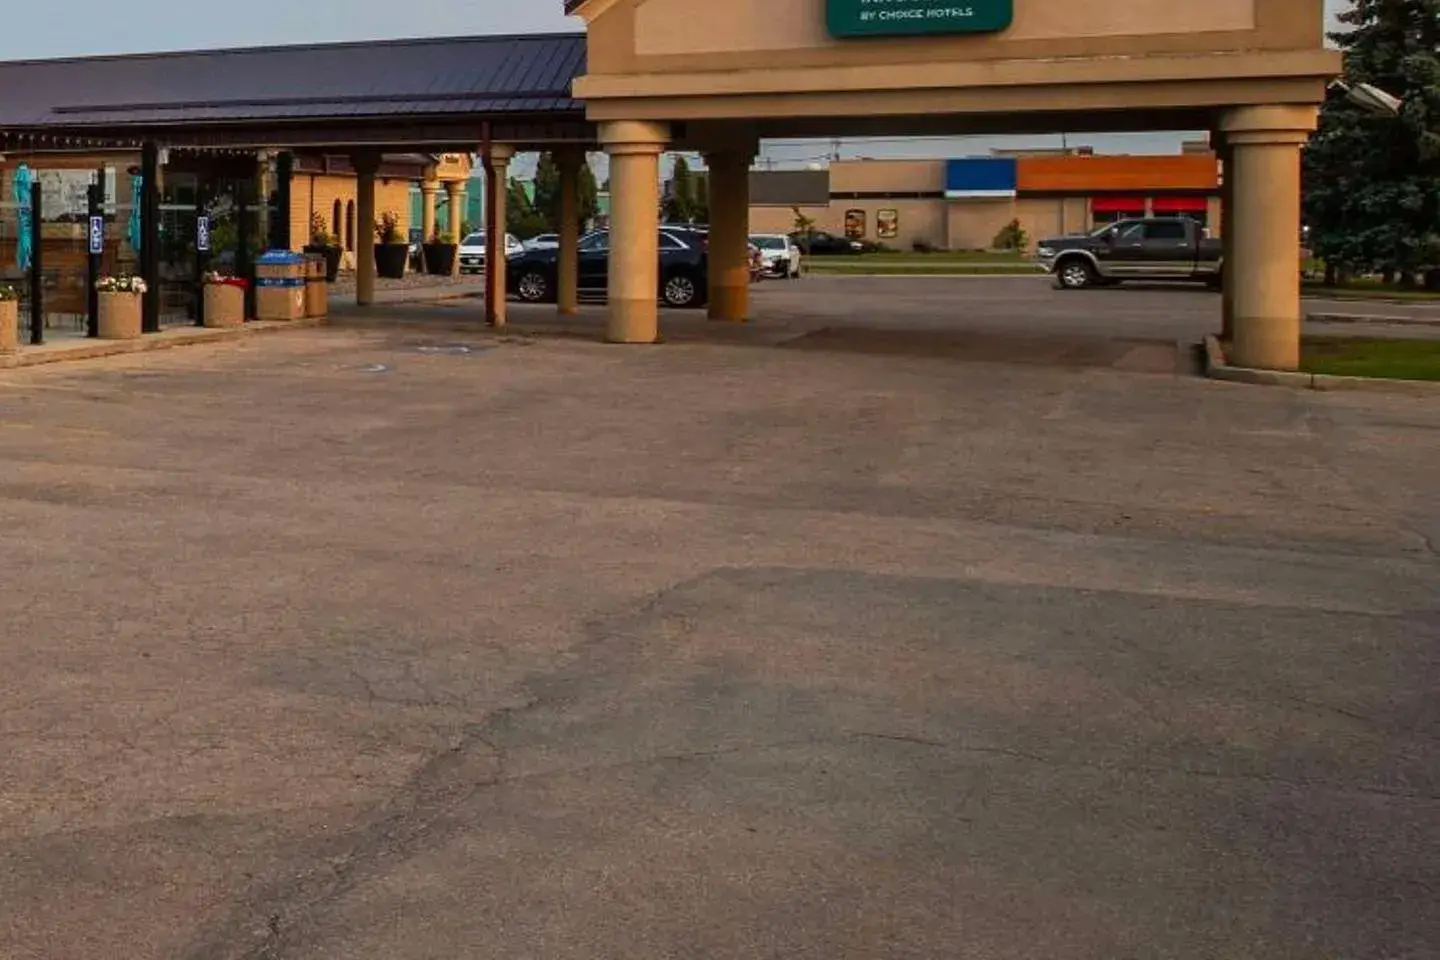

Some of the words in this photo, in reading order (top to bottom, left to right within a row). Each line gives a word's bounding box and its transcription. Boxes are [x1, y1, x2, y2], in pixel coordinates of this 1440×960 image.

[861, 10, 876, 20] BY
[878, 8, 924, 20] CHOICE
[926, 7, 973, 19] HOTELS
